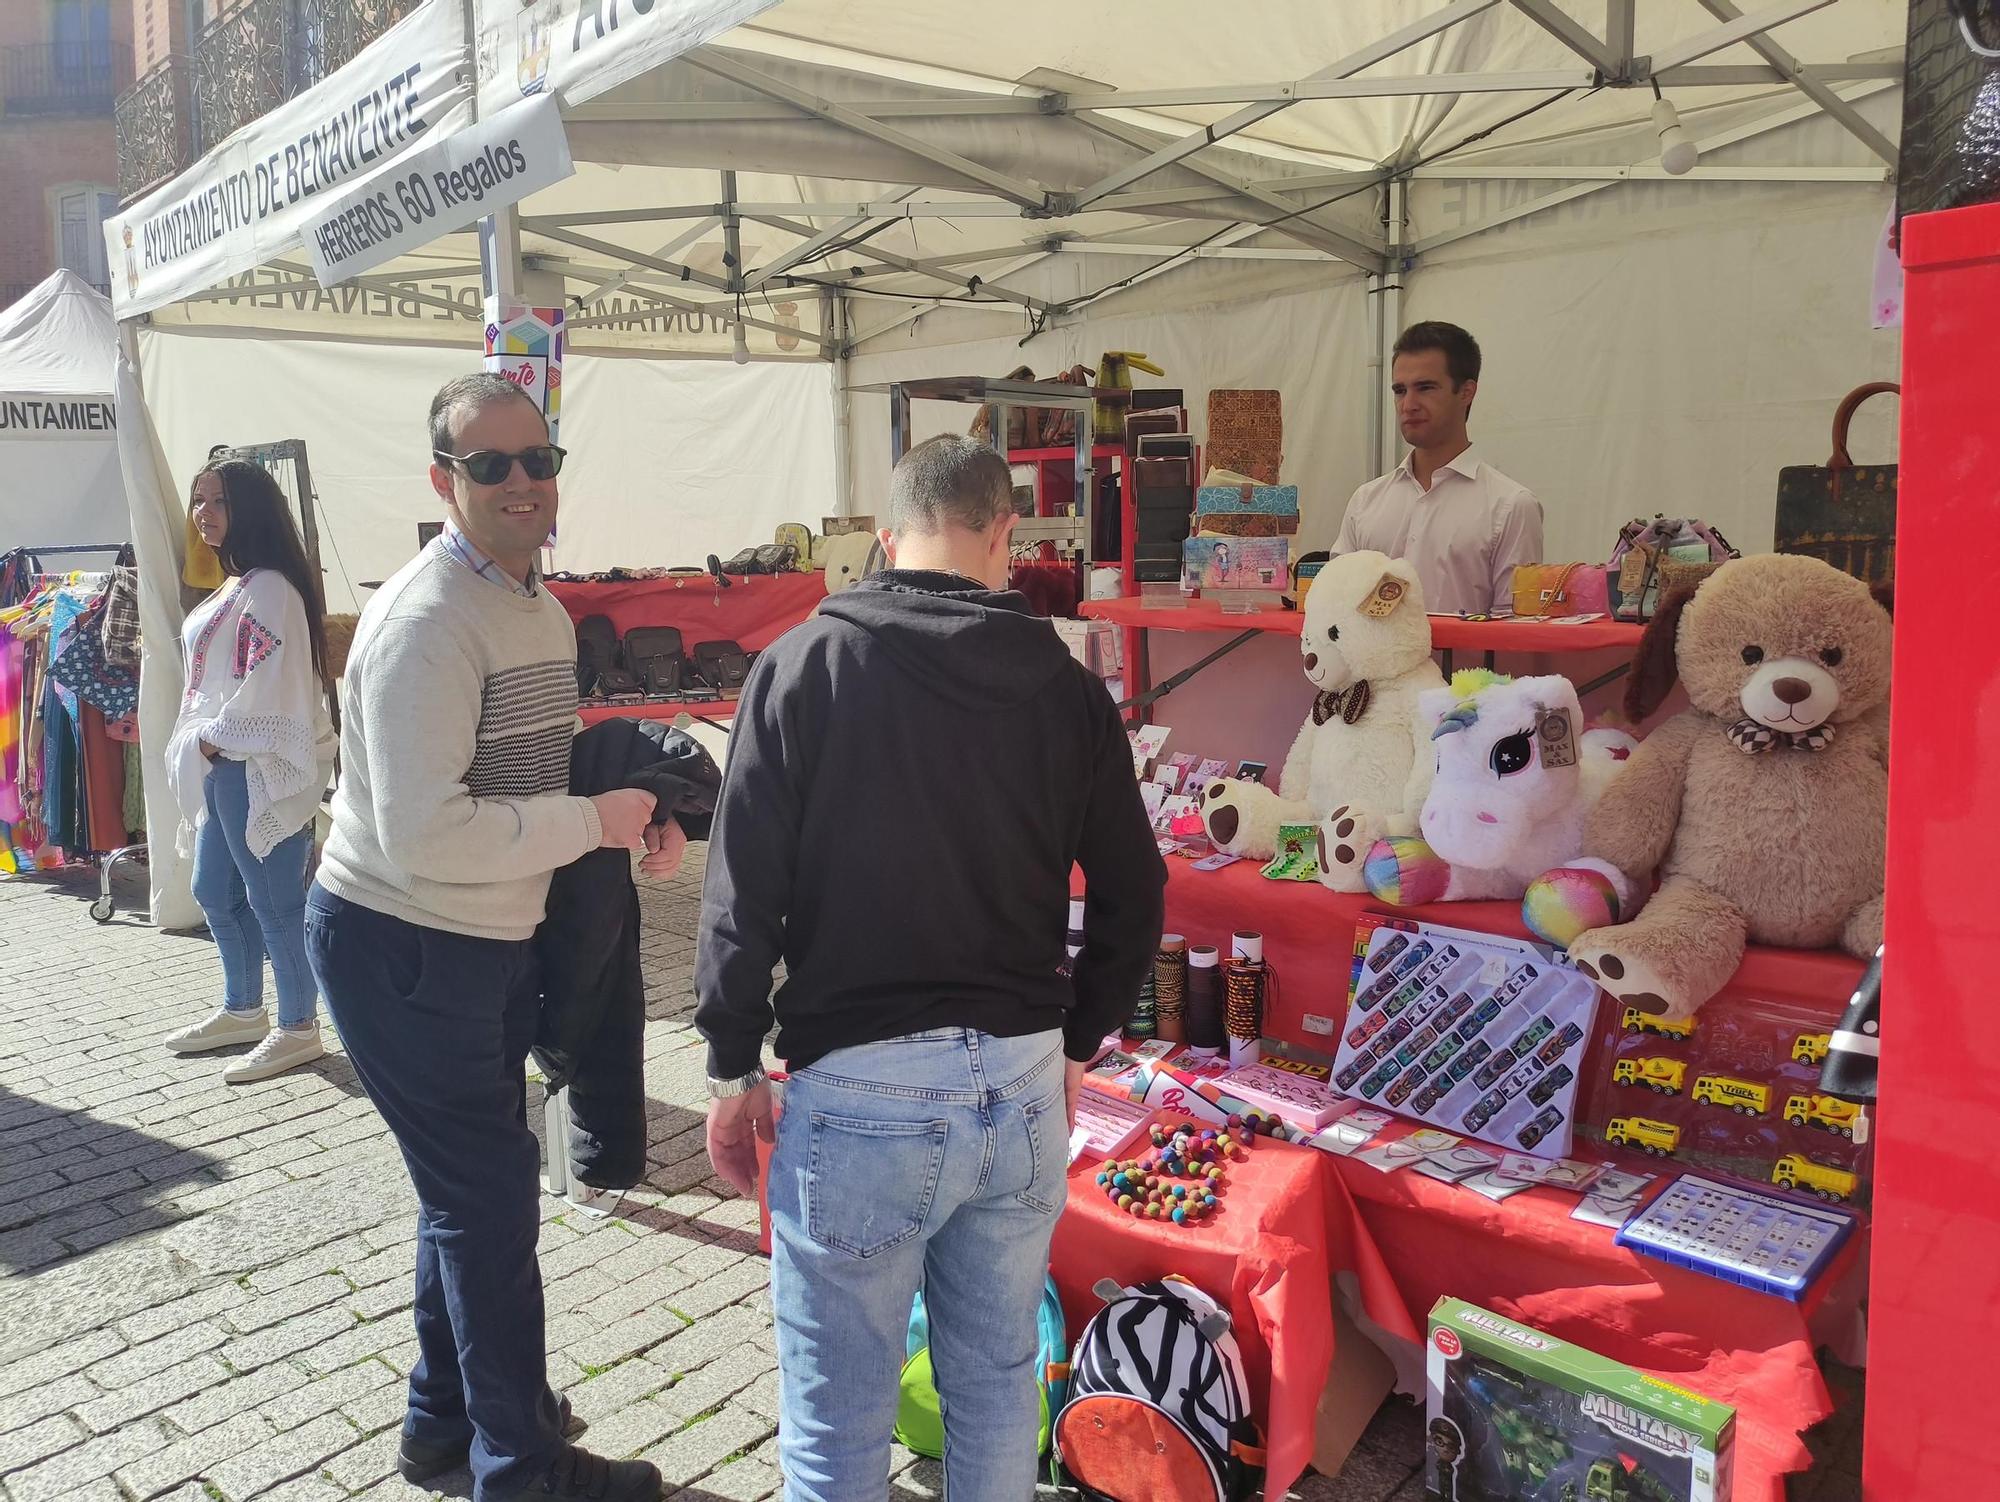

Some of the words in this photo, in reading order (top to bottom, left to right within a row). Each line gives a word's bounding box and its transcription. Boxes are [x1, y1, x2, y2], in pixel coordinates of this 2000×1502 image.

[143, 168, 251, 269] AYUNTAMIENTO
[255, 151, 285, 219] DE
[284, 62, 428, 205] BENAVENTE
[314, 191, 404, 267] HERREROS
[395, 172, 436, 225] 60
[433, 139, 526, 209] Regalos
[1725, 1084, 1756, 1098] Truck
[1458, 1310, 1558, 1350] MILITARY
[1583, 1392, 1702, 1453] MILITARY
[1616, 1422, 1640, 1438] TOYS
[1639, 1431, 1672, 1450] SERIES
